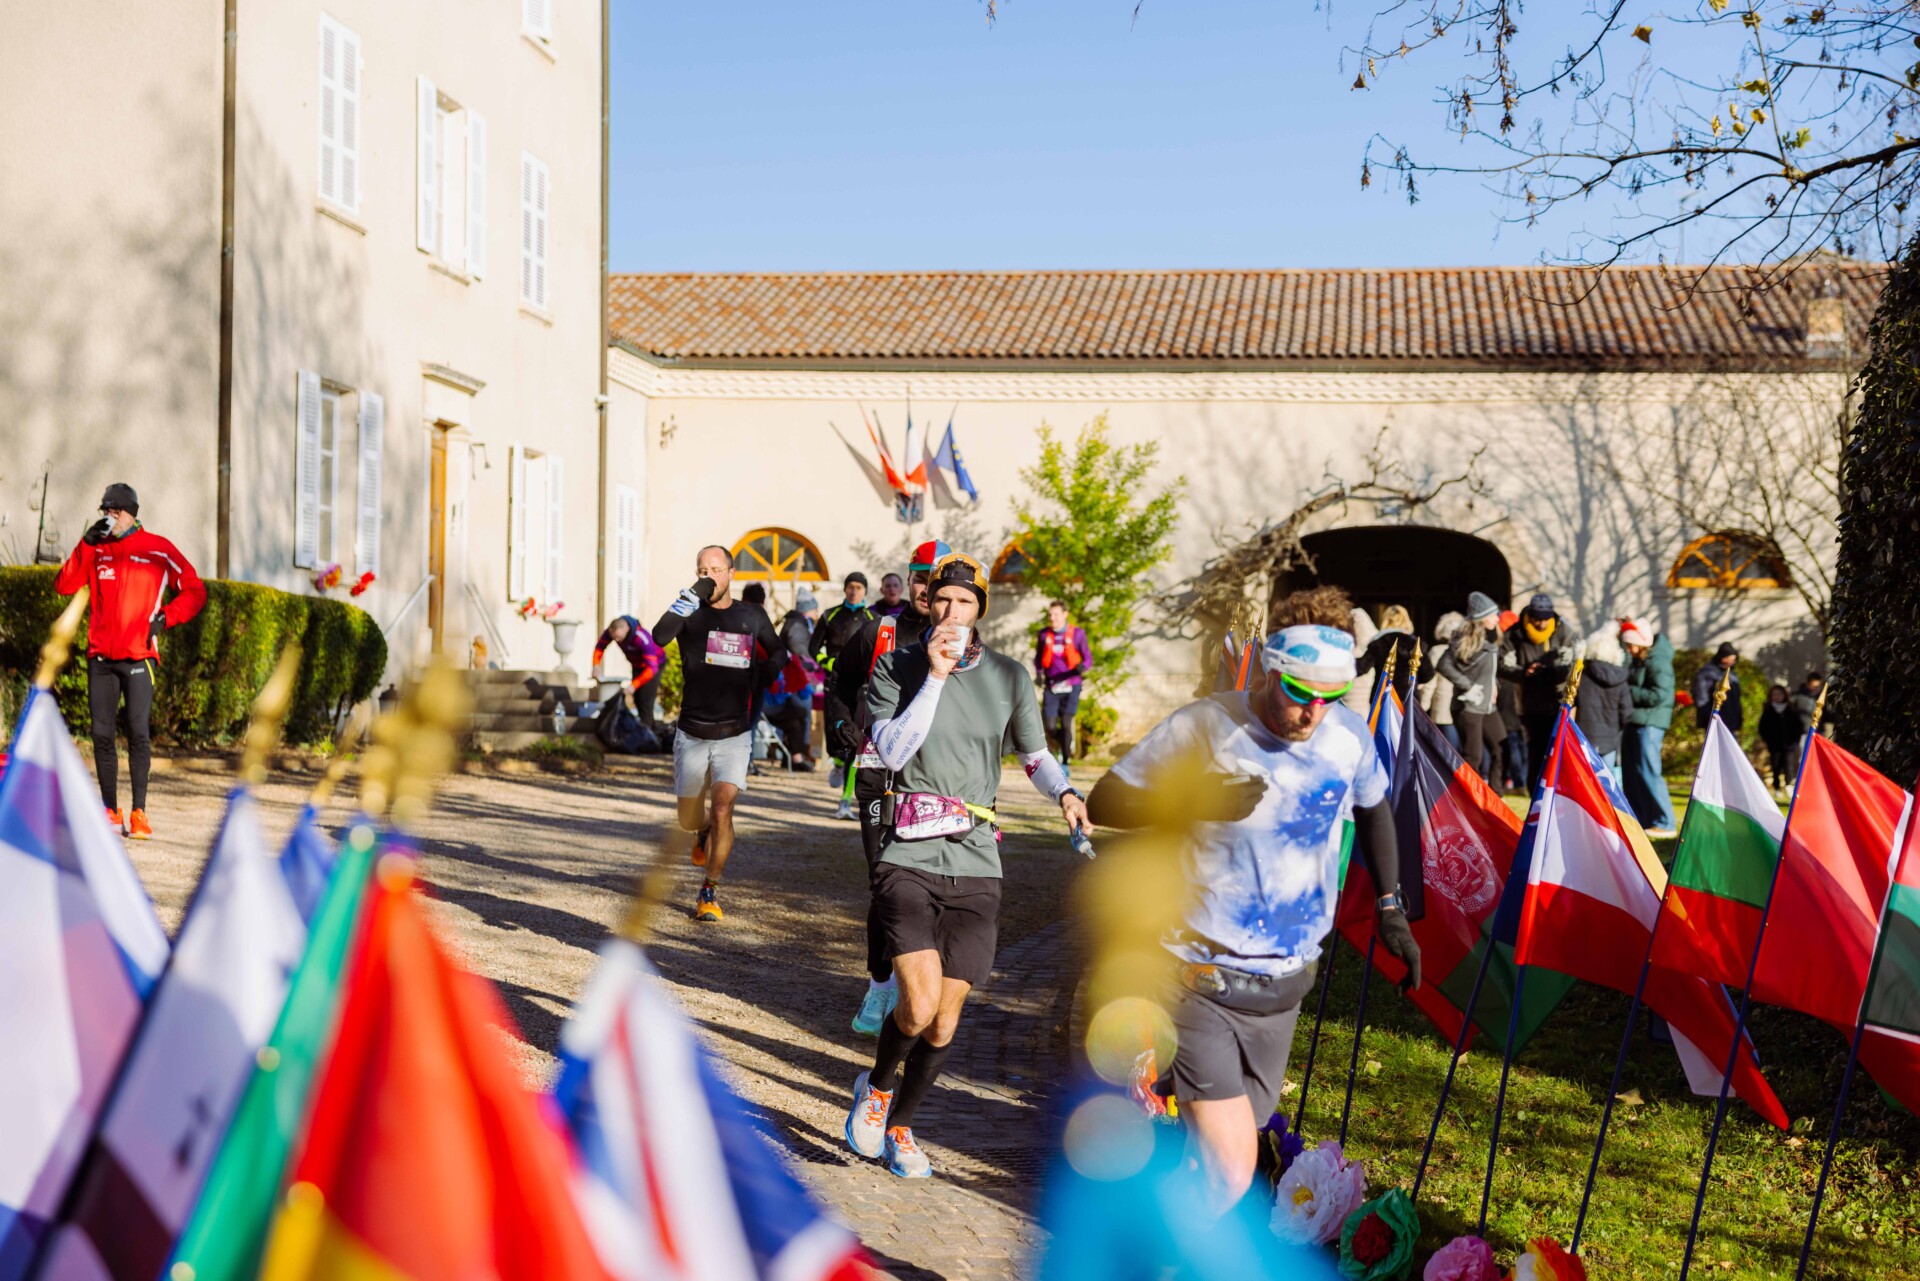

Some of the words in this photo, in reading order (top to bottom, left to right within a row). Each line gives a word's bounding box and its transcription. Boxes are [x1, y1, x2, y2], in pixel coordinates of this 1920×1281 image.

[886, 737, 896, 755] DEFI
[893, 728, 903, 740] DE
[899, 711, 912, 728] THAU
[896, 746, 911, 765] SWIM
[908, 731, 920, 747] RUN
